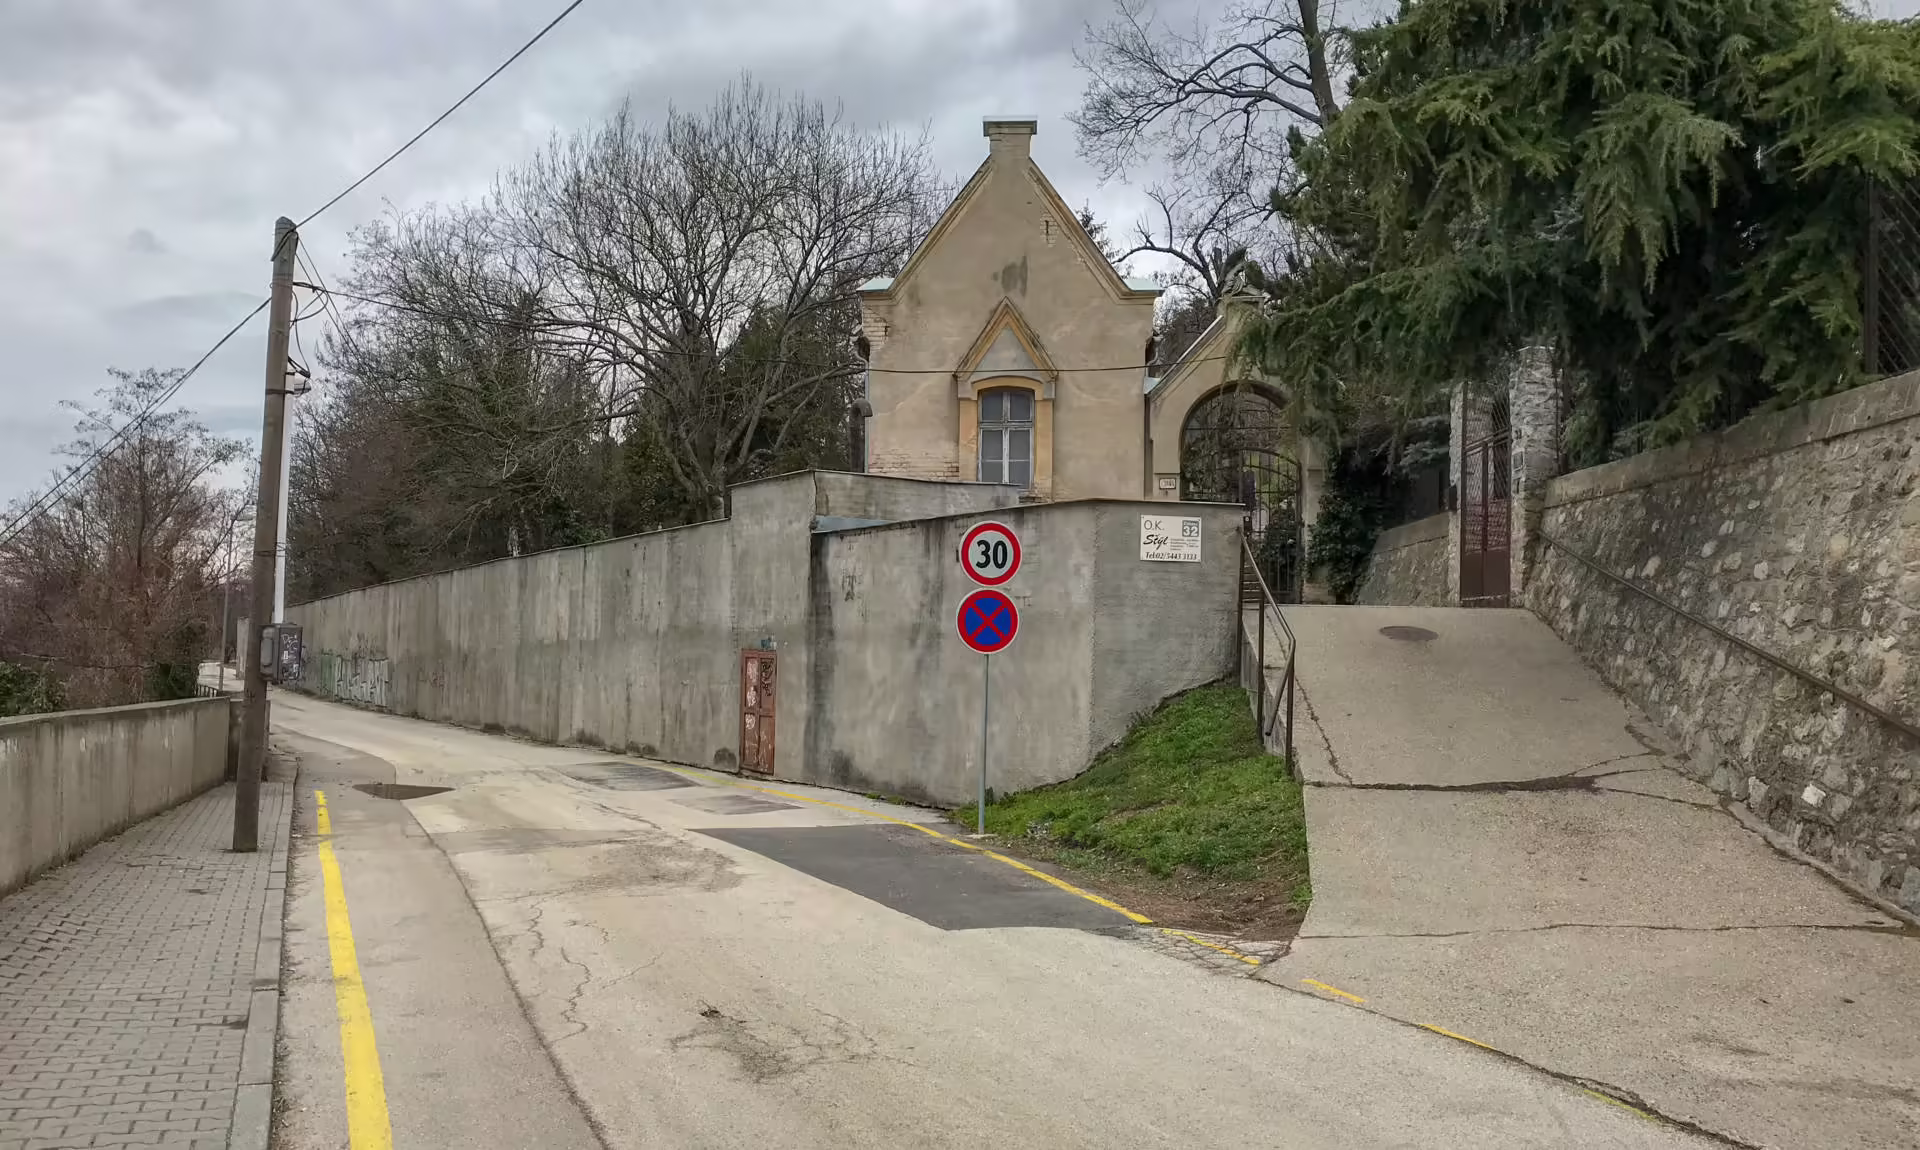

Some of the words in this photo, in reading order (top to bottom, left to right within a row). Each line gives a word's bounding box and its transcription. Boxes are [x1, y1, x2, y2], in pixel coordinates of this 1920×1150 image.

[1144, 519, 1165, 531] O.K.
[1183, 525, 1198, 537] 32
[975, 539, 1008, 569] 30
